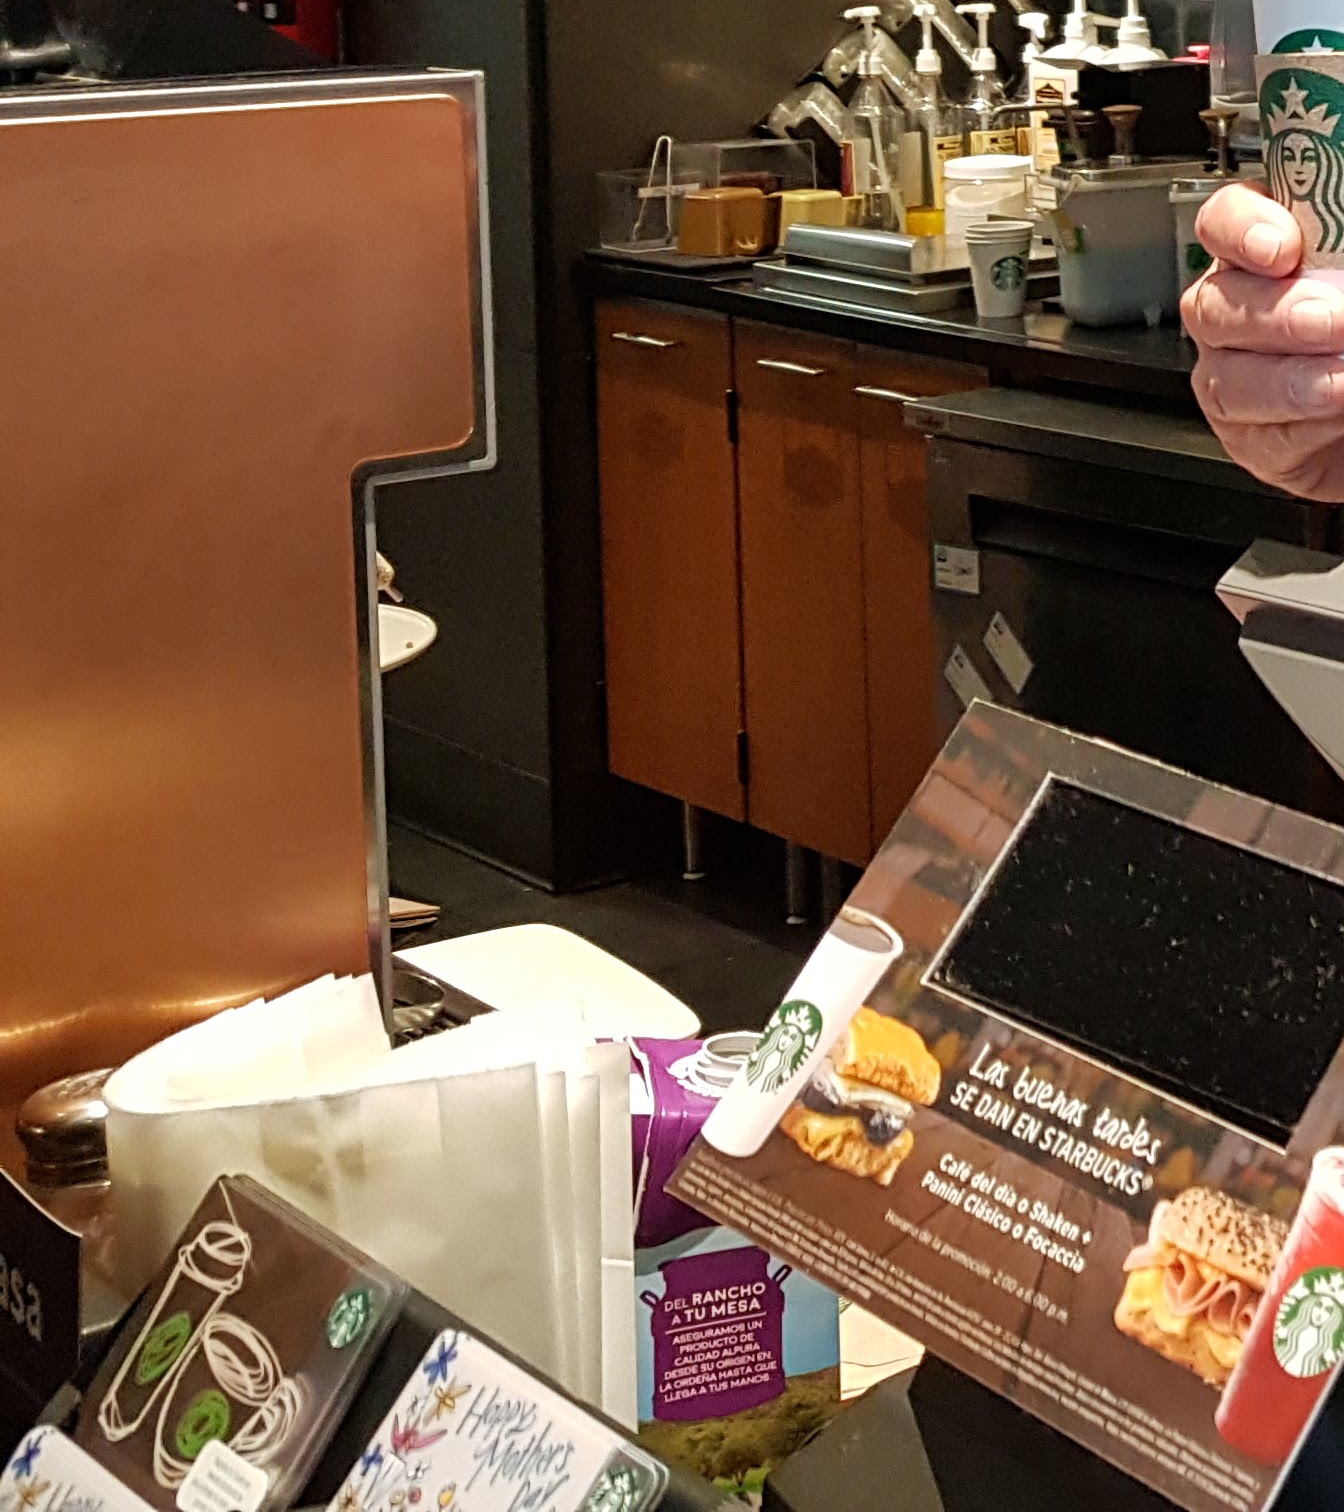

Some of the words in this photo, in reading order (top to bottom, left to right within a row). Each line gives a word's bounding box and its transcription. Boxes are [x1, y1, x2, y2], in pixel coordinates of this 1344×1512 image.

[950, 1080, 976, 1112] SE
[973, 1095, 1015, 1136] DAN
[1012, 1113, 1040, 1144] EN
[970, 1043, 1008, 1088] Las
[1013, 1066, 1088, 1131] buenas
[1093, 1107, 1162, 1165] tardes
[939, 1152, 972, 1182] Café
[970, 1168, 997, 1196] del
[1017, 1197, 1029, 1212] o
[1029, 1199, 1082, 1243] Shaken
[921, 1170, 963, 1206] Panini
[963, 1192, 1011, 1233] Clásico
[1010, 1221, 1024, 1239] o
[1023, 1225, 1087, 1274] Focaccia
[664, 1298, 689, 1312] DEL
[692, 1282, 766, 1306] RANCHO
[671, 1314, 681, 1326] A
[684, 1307, 706, 1322] TU
[711, 1297, 761, 1318] MESA
[672, 1323, 745, 1345] ASEGURAMOS
[747, 1320, 763, 1330] UN
[680, 1335, 738, 1354] PRODUCTO
[740, 1332, 755, 1342] DE
[664, 1364, 698, 1380] DESDE
[700, 1361, 715, 1373] SU
[757, 1350, 771, 1362] EN
[674, 1350, 720, 1367] CALIDAD
[659, 1382, 673, 1393] LA
[718, 1365, 753, 1380] HASTA
[754, 1360, 777, 1372] QUE
[664, 1387, 698, 1403] LLEGA
[698, 1386, 707, 1394] A
[709, 1380, 729, 1393] TUS
[730, 1373, 770, 1388] MANOS
